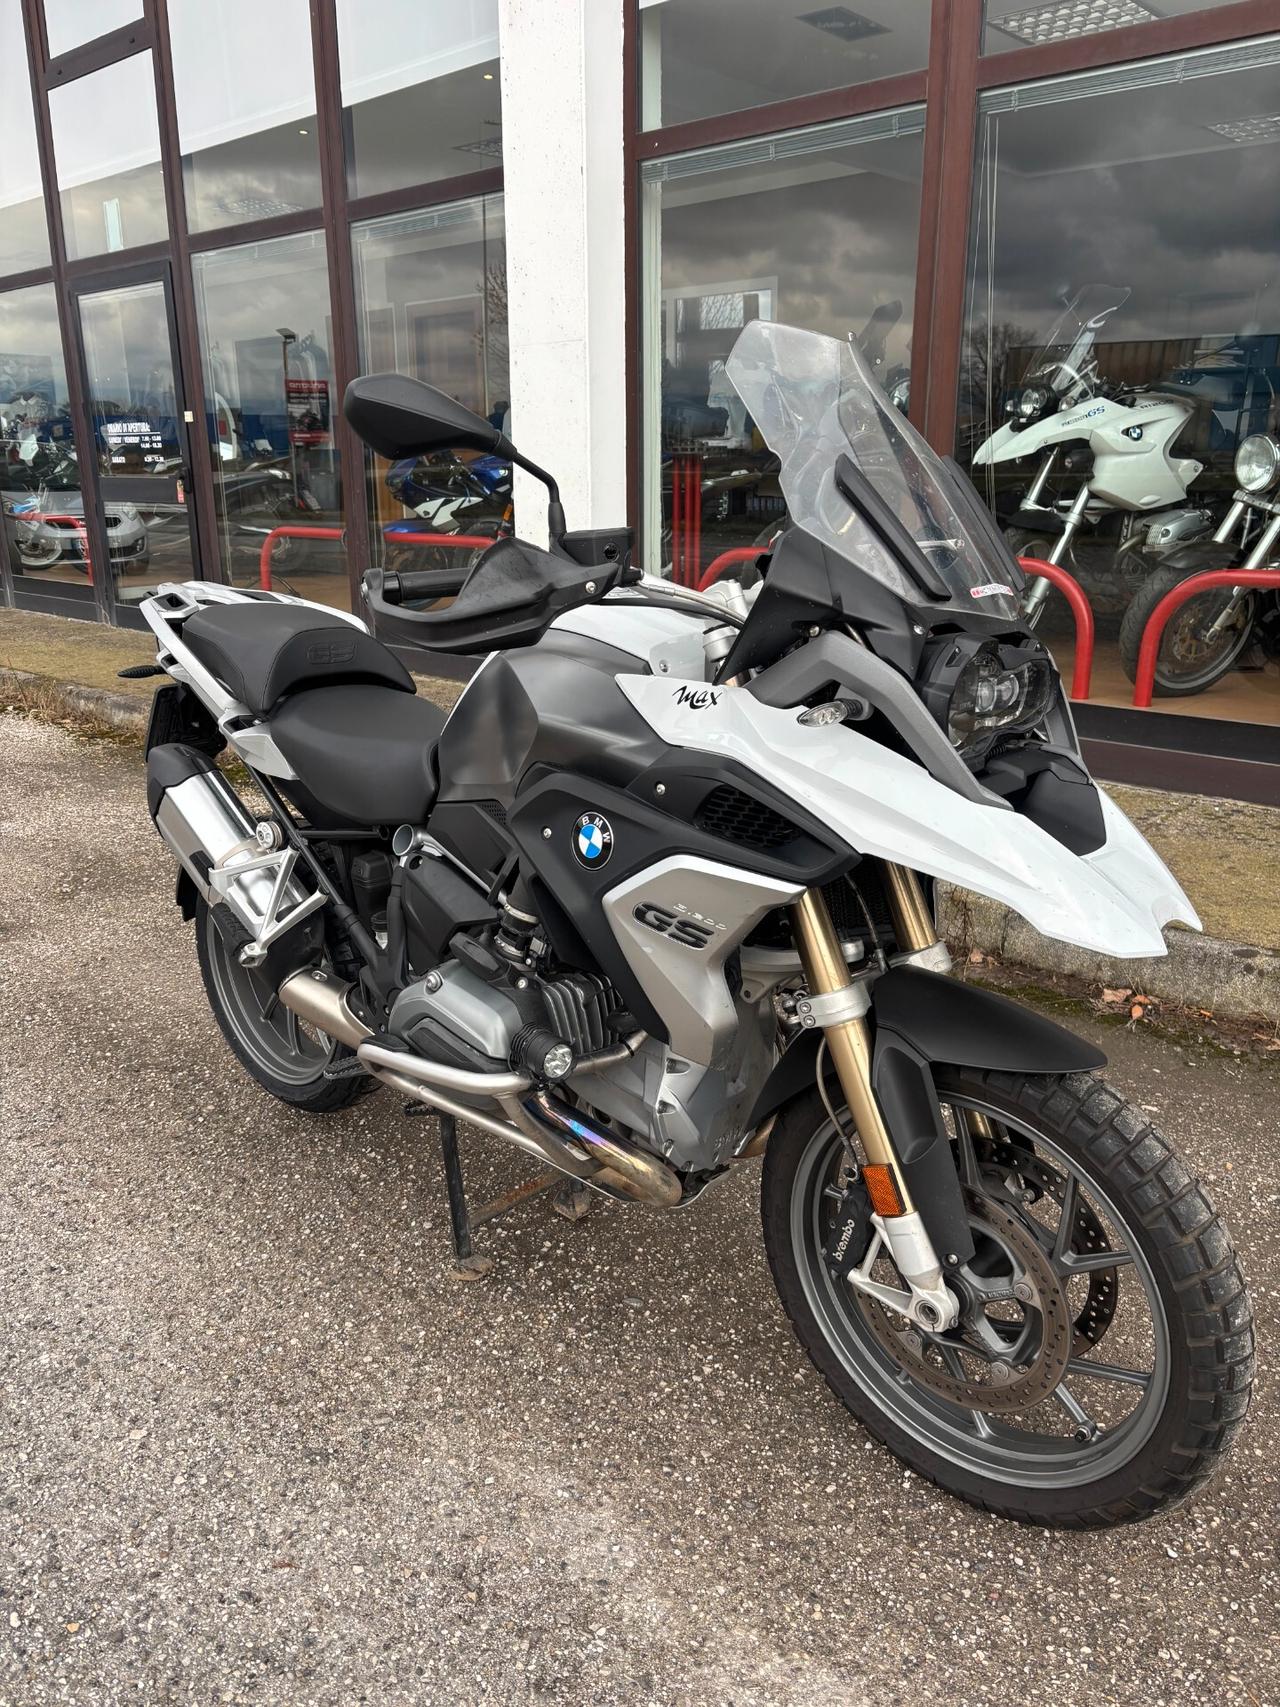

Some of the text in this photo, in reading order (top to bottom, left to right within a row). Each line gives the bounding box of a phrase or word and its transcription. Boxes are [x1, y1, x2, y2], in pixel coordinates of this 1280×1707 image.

[581, 815, 611, 844] BMW
[632, 900, 715, 951] GS
[832, 1219, 855, 1262] brembo
